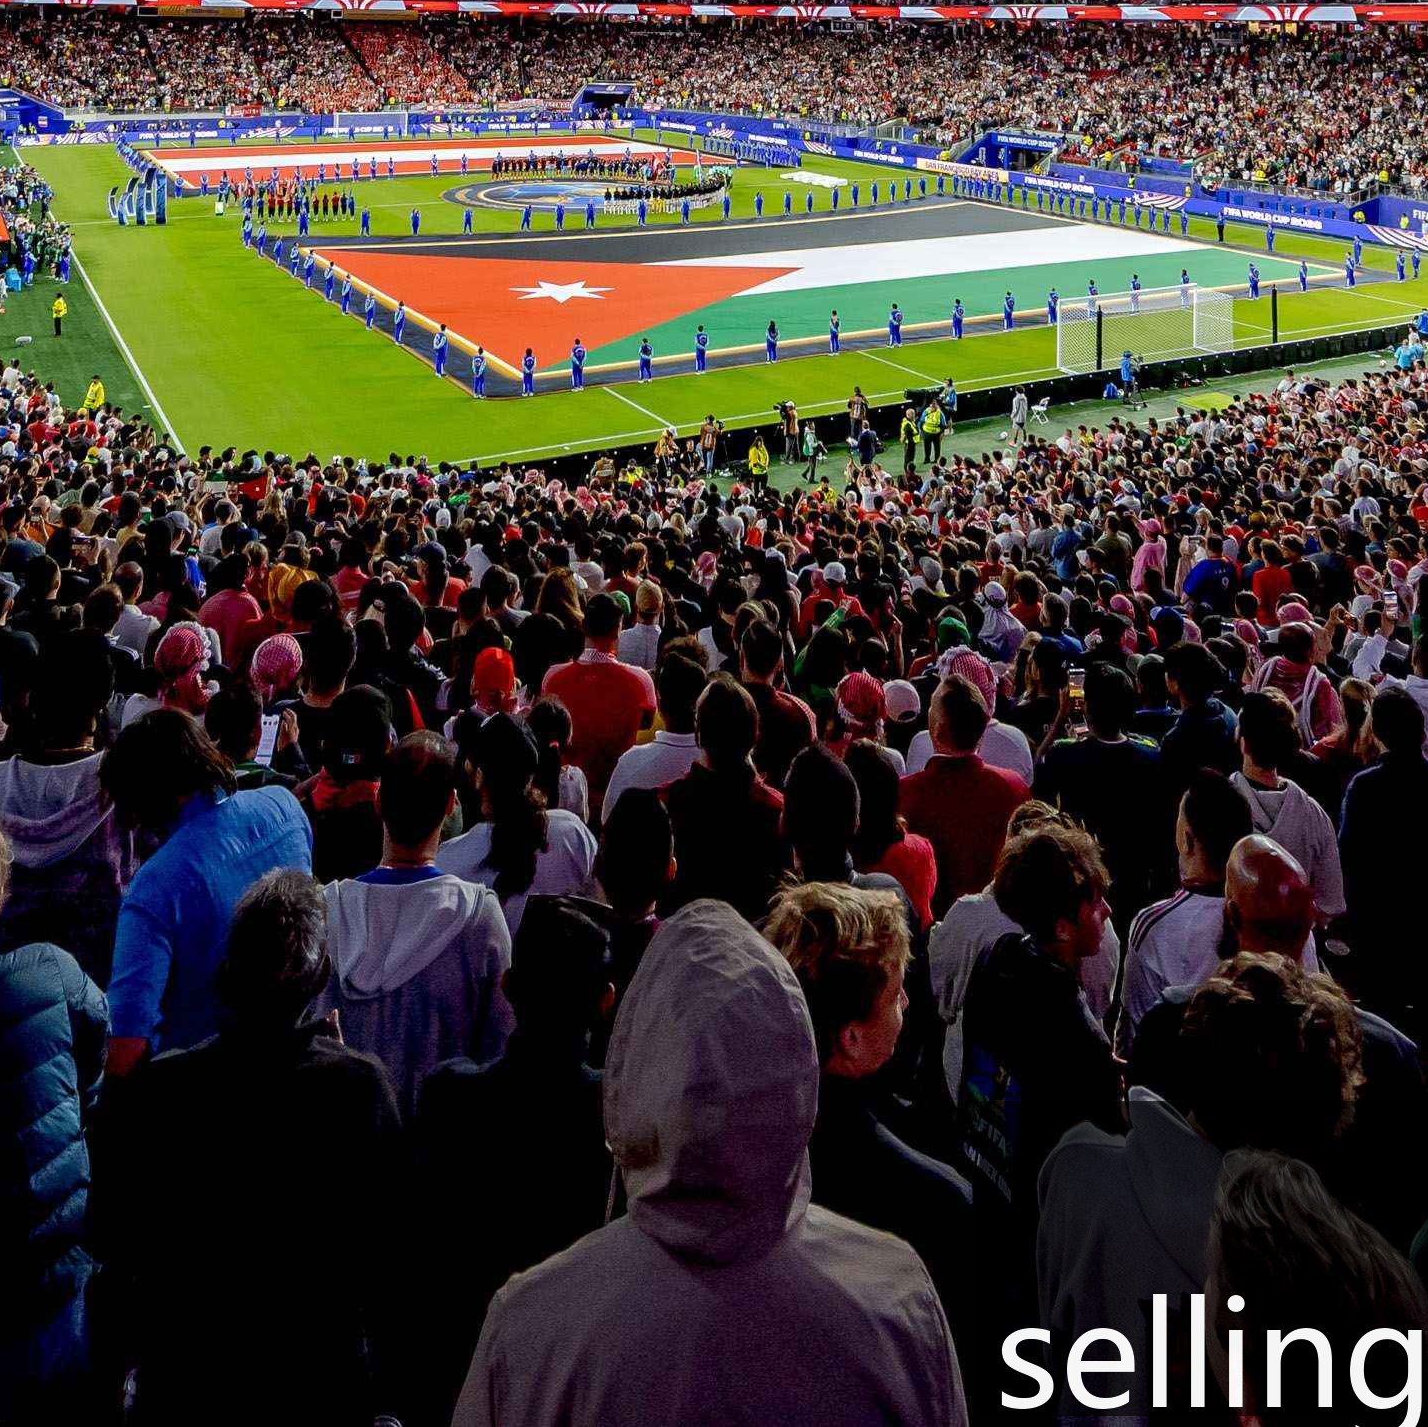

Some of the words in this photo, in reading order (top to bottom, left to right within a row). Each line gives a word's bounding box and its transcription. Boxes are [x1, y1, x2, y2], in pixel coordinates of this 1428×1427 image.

[1223, 206, 1242, 218] FIFA
[1242, 210, 1272, 222] WORLD
[1273, 214, 1290, 224] CUP
